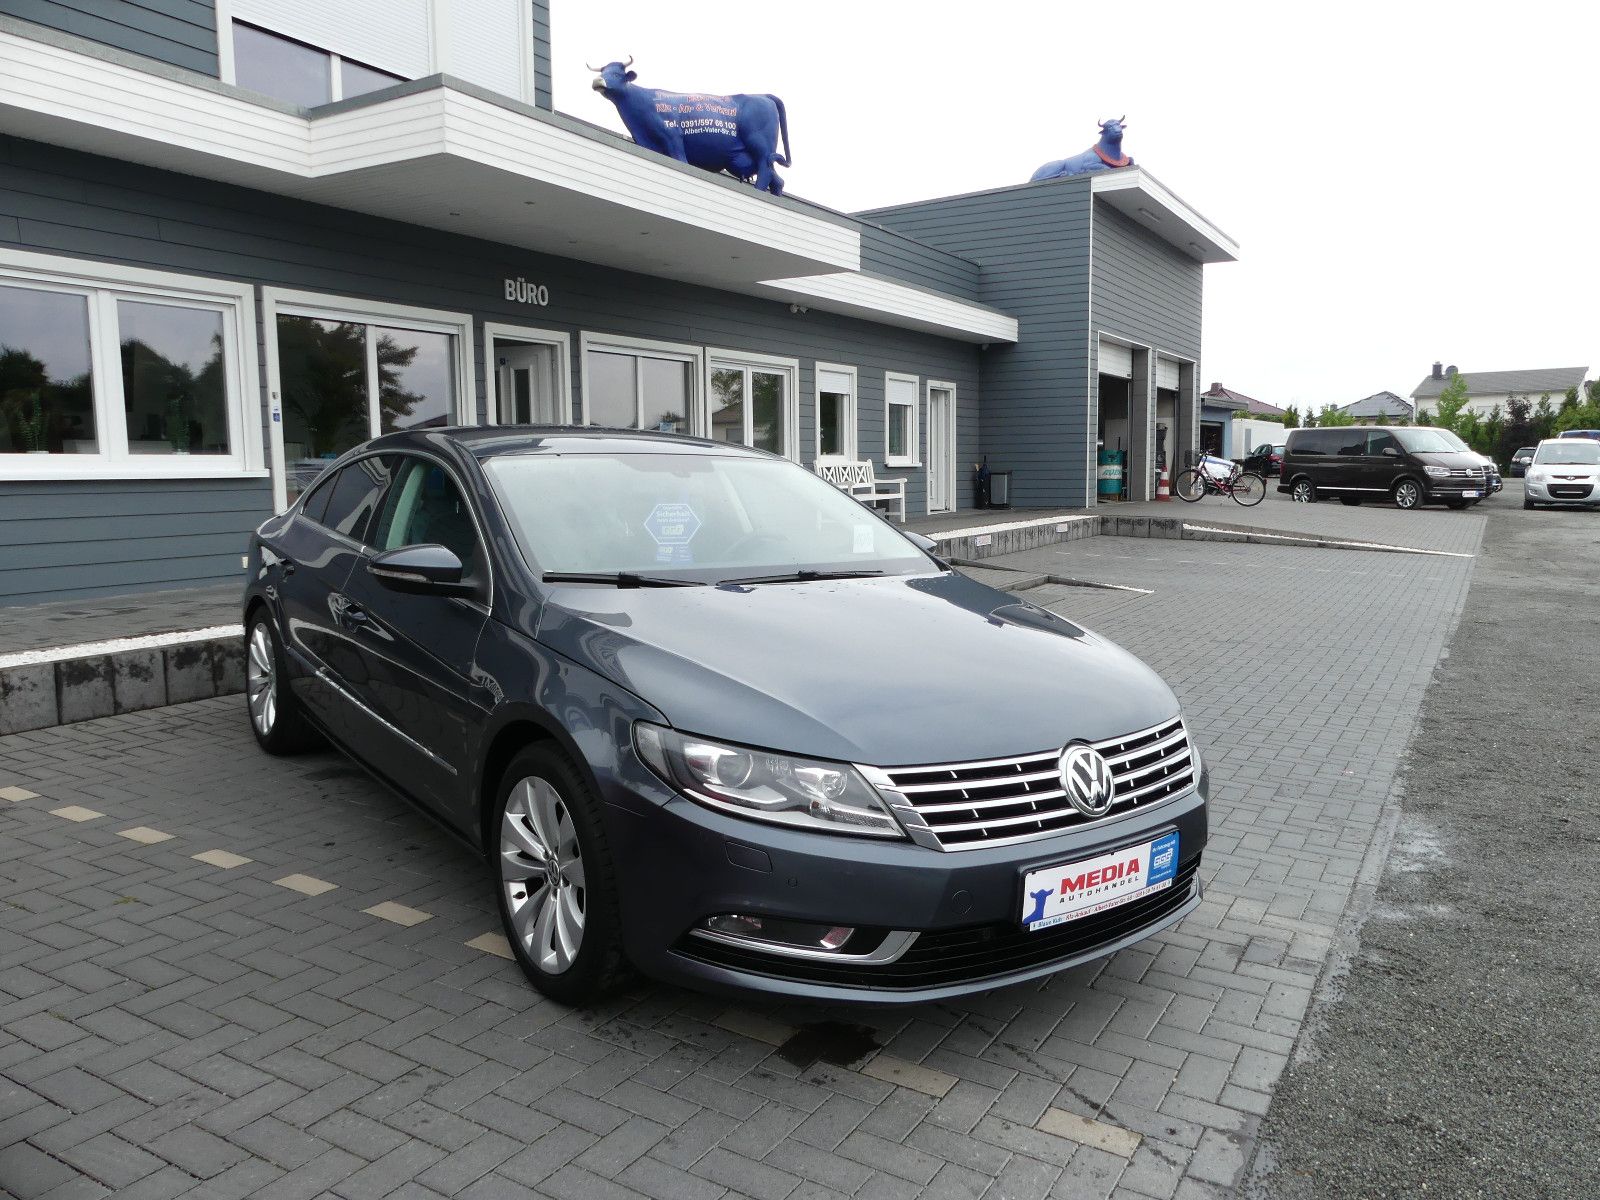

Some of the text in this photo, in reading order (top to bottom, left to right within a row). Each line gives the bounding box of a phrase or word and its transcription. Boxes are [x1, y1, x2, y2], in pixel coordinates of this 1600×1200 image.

[664, 120, 679, 128] Tel.
[681, 119, 713, 128] 0391/597
[504, 276, 549, 306] BÜRO
[1060, 858, 1140, 895] MEDIA
[1060, 876, 1139, 903] AUTOHANDEL
